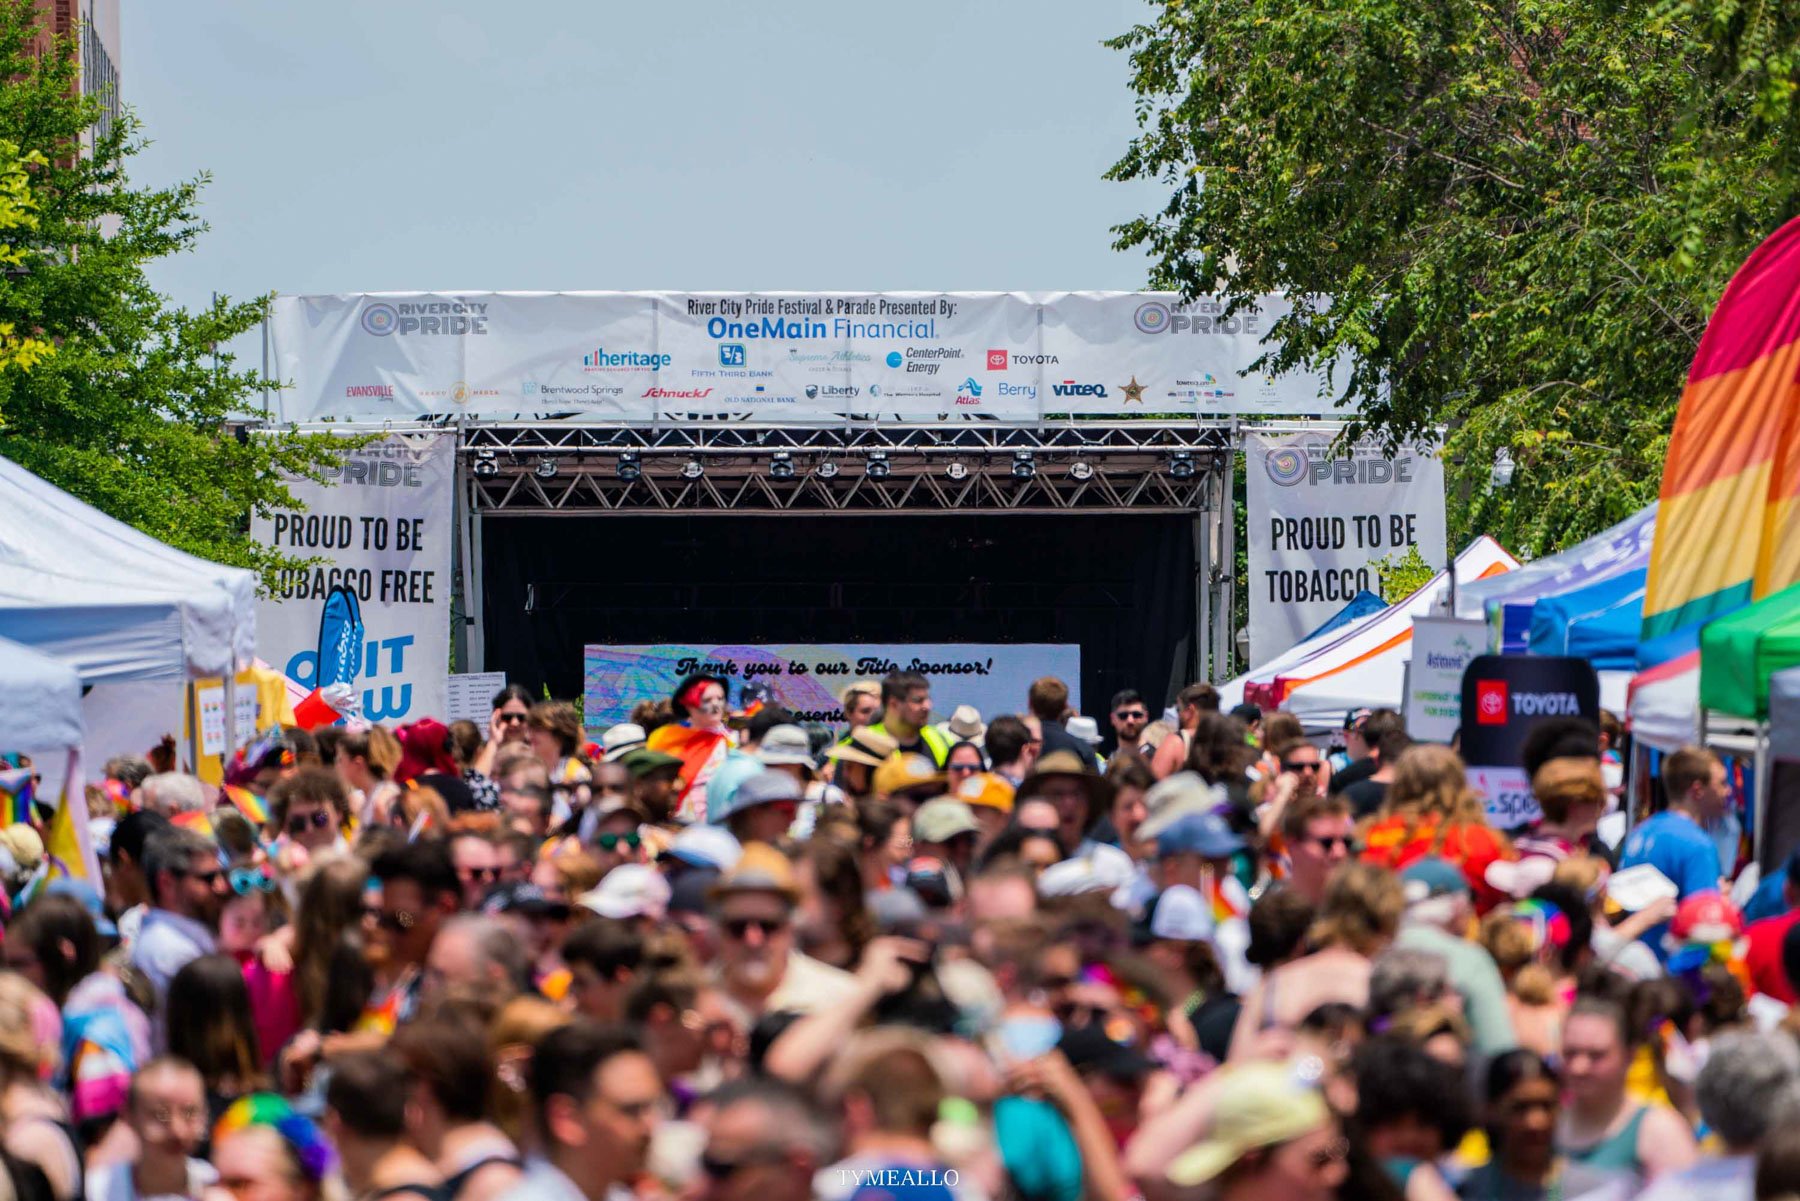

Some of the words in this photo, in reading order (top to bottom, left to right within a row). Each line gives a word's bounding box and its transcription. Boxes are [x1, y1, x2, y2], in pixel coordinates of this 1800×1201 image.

[398, 302, 452, 314] RIVER
[688, 298, 717, 315] River
[720, 298, 742, 319] City
[745, 298, 774, 315] Pride
[778, 298, 821, 315] Festival
[825, 299, 834, 315] &
[837, 298, 876, 315] Parade
[879, 298, 936, 315] Presented
[940, 298, 957, 319] By:
[1170, 302, 1222, 314] RIVER
[399, 315, 488, 336] PRIDE
[707, 317, 827, 339] OneMain
[1170, 315, 1259, 335] PRIDE
[599, 347, 672, 371] heritage
[906, 347, 962, 359] CenterPoint
[1012, 354, 1060, 365] TOYOTA
[906, 362, 940, 375] Energy
[346, 384, 394, 398] EVANSVILLE
[541, 384, 590, 394] Brentwood
[591, 384, 624, 396] Springs
[640, 387, 715, 398] Schnucks
[821, 385, 860, 396] Liberty
[955, 395, 980, 405] Atlas
[998, 382, 1037, 399] Berry
[319, 460, 423, 487] PRIDE
[1308, 457, 1413, 486] PRIDE
[274, 513, 352, 550] PROUD
[360, 516, 389, 551] TO
[396, 518, 424, 552] BE
[1271, 516, 1345, 551] PROUD
[1352, 514, 1381, 549] TO
[1389, 513, 1417, 547] BE
[265, 566, 372, 601] OBACCO
[380, 569, 435, 604] FREE
[285, 634, 414, 692] QIT
[674, 657, 738, 675] Thank
[742, 661, 782, 680] you
[788, 660, 808, 675] to
[815, 661, 850, 675] our
[1510, 691, 1580, 716] TOYOTA
